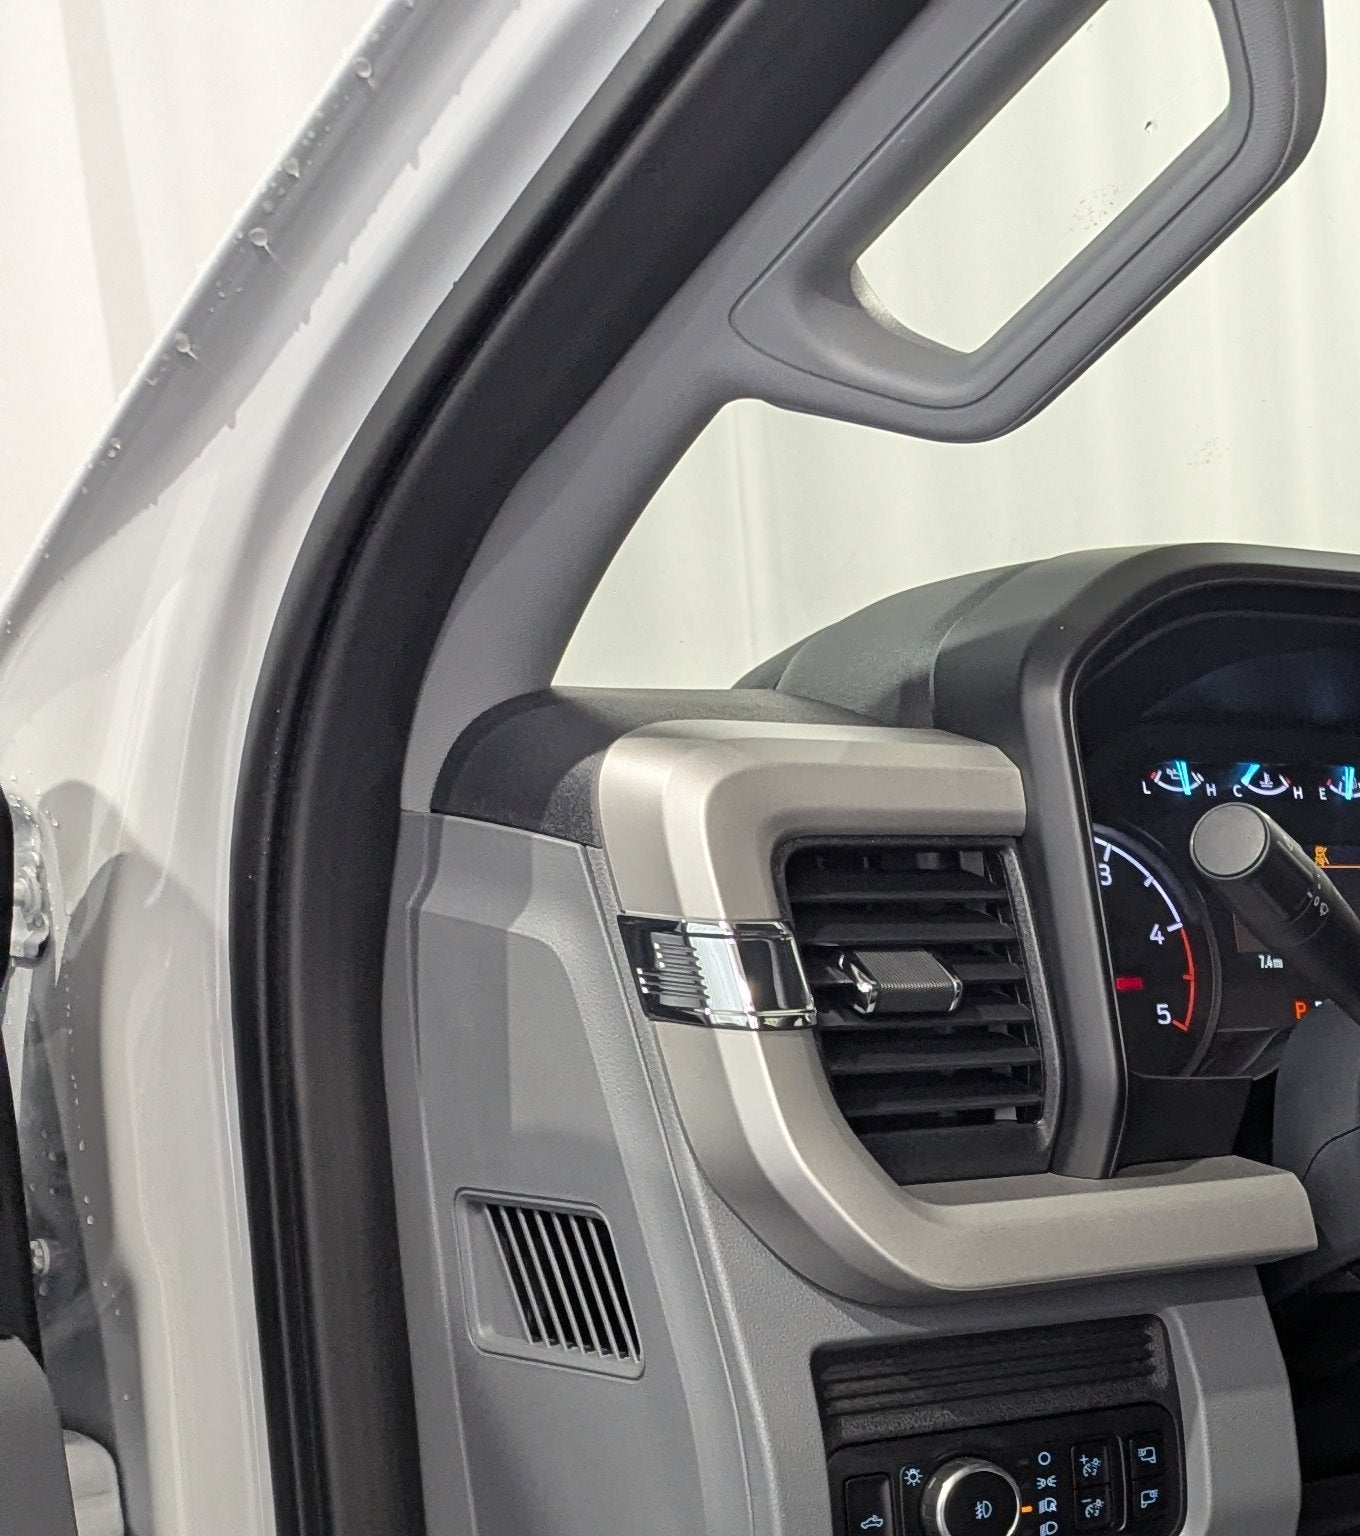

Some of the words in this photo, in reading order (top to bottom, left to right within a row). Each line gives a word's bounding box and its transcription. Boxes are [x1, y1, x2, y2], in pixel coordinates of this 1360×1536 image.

[1142, 780, 1151, 795] L
[1206, 784, 1217, 797] H
[1232, 785, 1243, 798] C
[1293, 787, 1304, 800] H
[1319, 787, 1328, 801] E
[1098, 864, 1112, 886] 3
[1149, 923, 1166, 945] 4
[1156, 1003, 1172, 1025] 5
[1294, 1001, 1308, 1020] P
